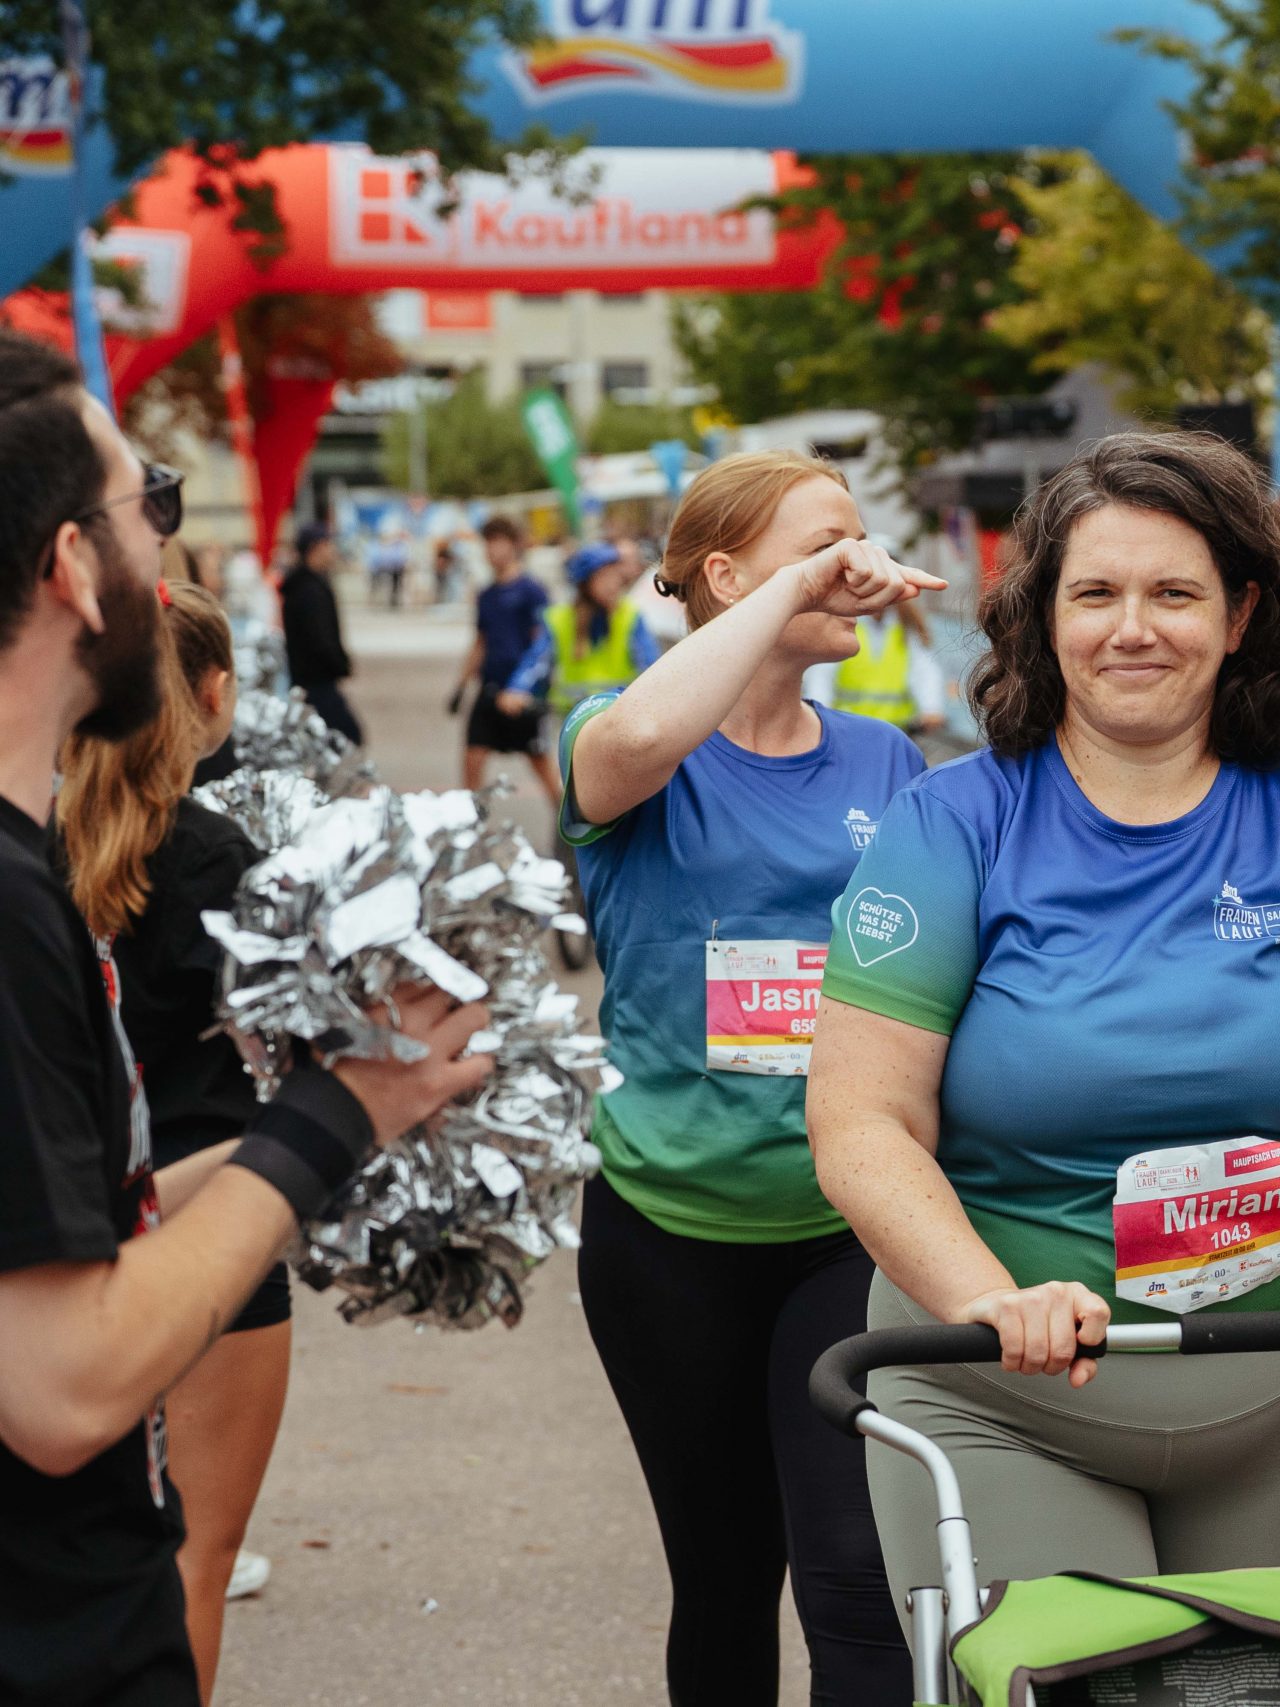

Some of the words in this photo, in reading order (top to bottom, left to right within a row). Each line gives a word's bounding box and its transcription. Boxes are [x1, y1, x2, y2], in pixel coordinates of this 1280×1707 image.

[859, 901, 905, 927] SCHÜTZE,
[859, 913, 879, 926] WAS
[881, 919, 898, 933] DU
[1219, 907, 1261, 925] FRAUEN
[856, 923, 893, 944] LIEBST.
[1220, 923, 1263, 939] LAUF
[1233, 1151, 1272, 1168] HAUPTSACH
[1137, 1177, 1157, 1188] LAUF
[1210, 1222, 1251, 1249] 1043
[1149, 1281, 1165, 1292] dm
